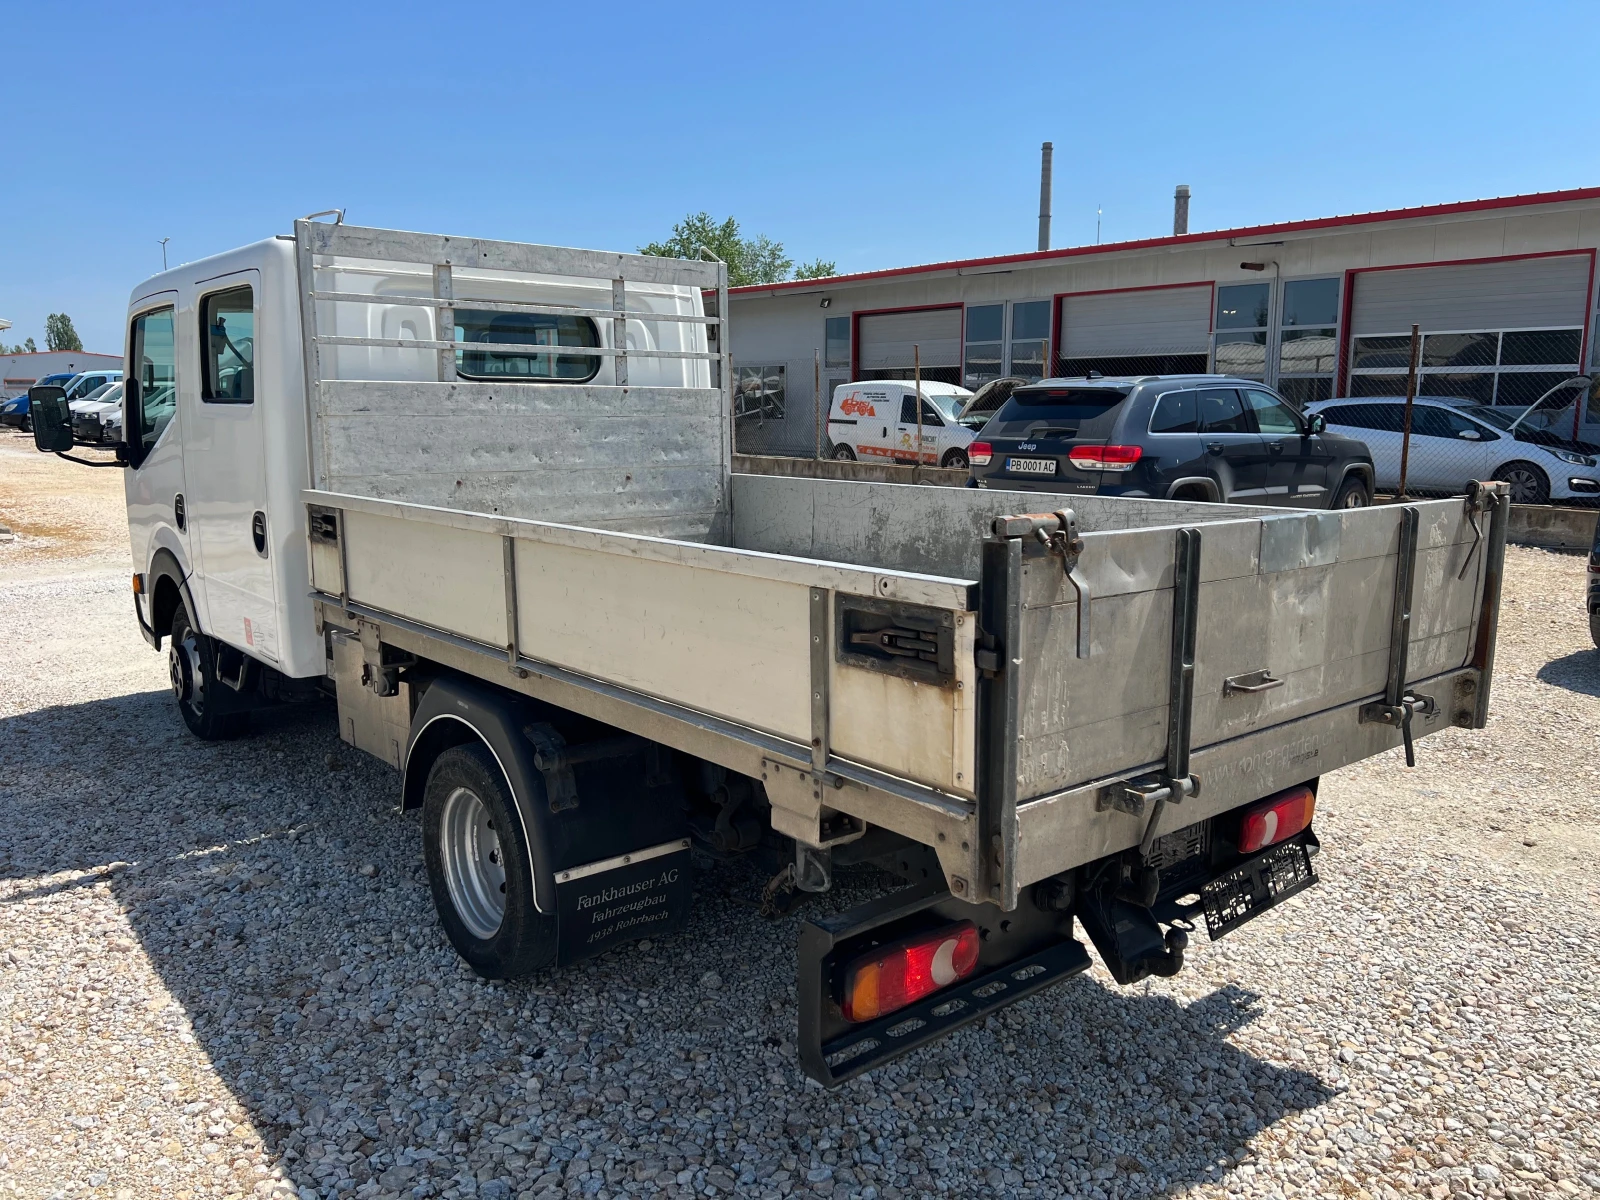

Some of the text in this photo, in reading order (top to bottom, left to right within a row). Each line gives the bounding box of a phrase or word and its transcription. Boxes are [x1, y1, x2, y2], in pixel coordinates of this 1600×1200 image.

[1018, 441, 1037, 452] Jeep
[1010, 459, 1055, 473] PB 0001 AC
[576, 868, 679, 911] Fankhauser AG
[591, 894, 666, 924] Fahrzeugbau
[586, 910, 669, 944] 4938 Rohrbach
